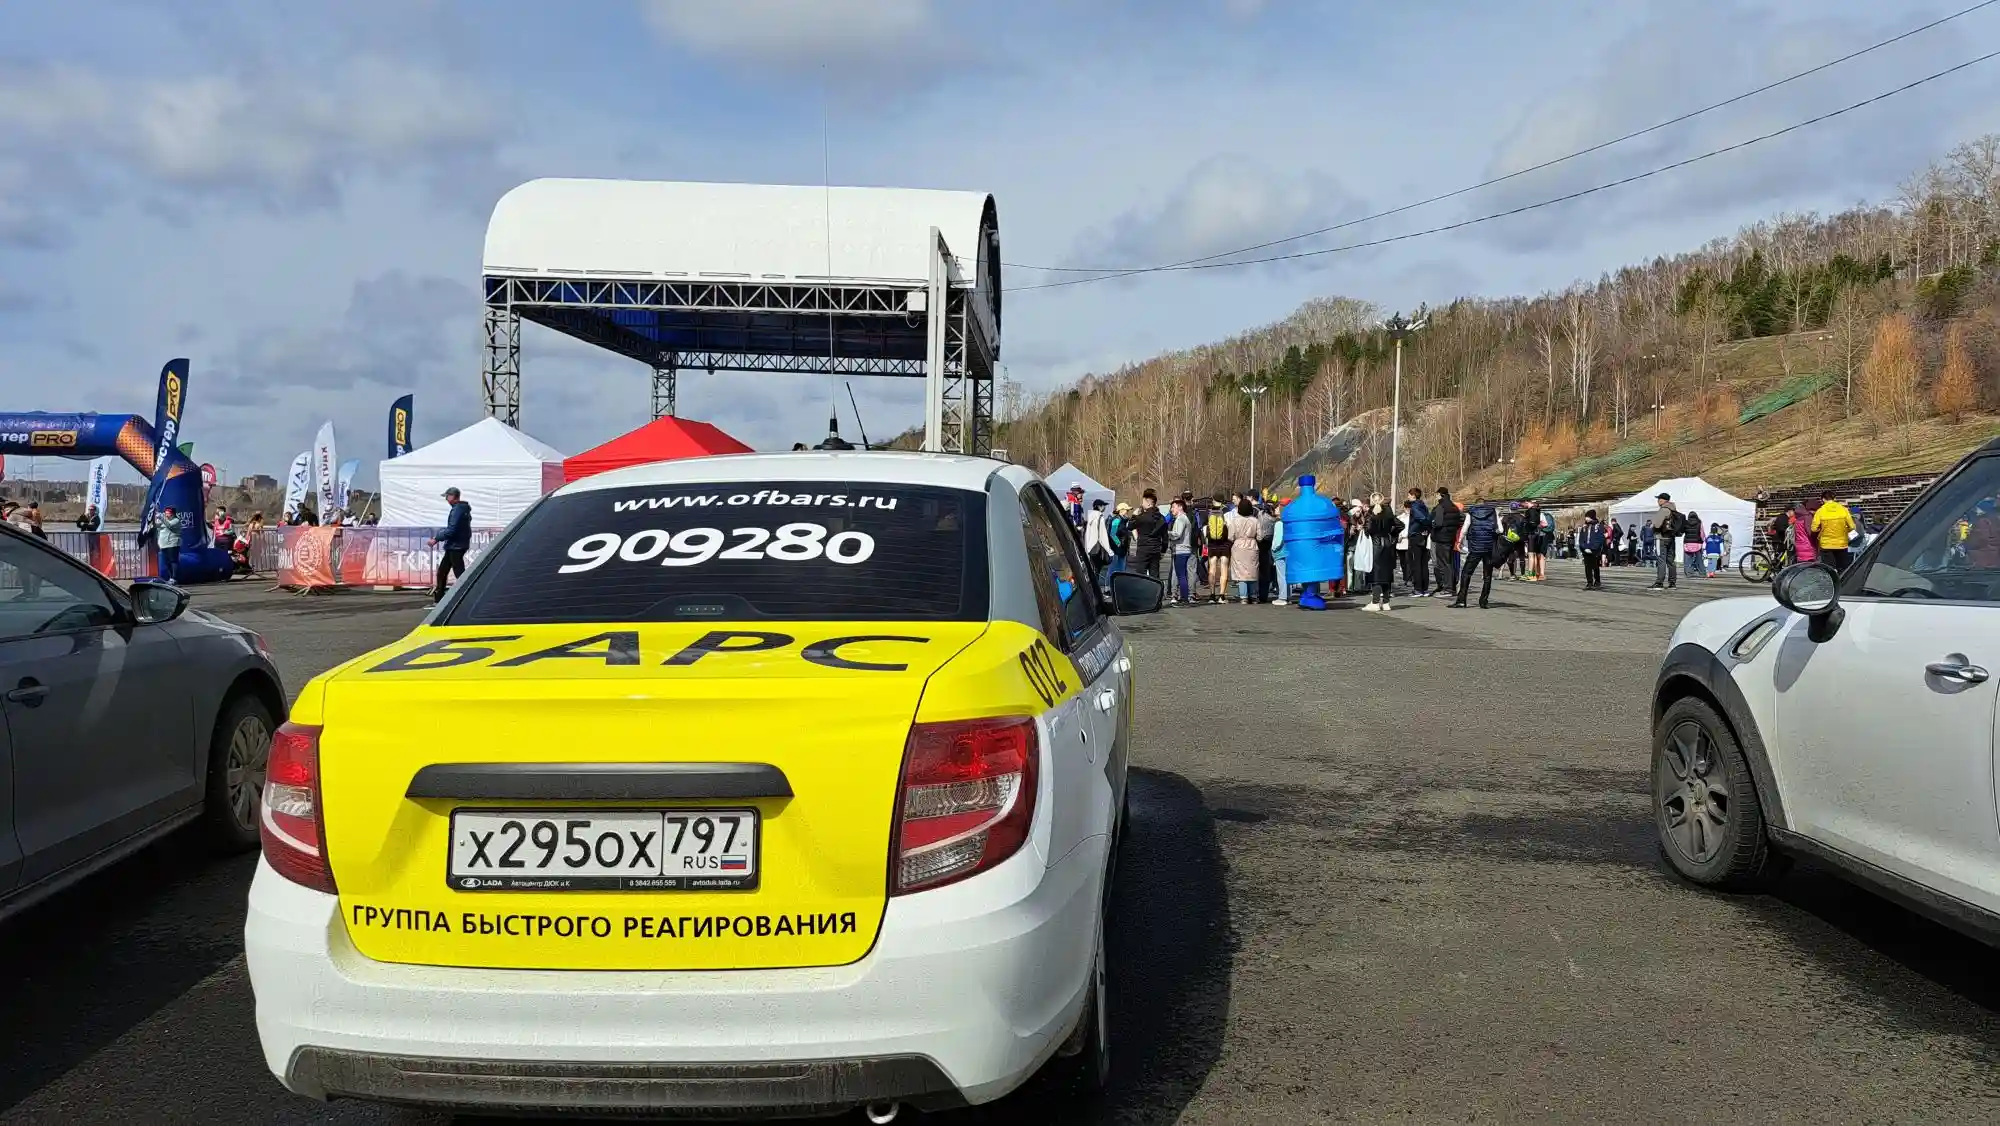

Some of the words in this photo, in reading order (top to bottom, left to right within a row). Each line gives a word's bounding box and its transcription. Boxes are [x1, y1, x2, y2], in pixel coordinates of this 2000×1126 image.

[33, 434, 73, 444] PRO
[614, 490, 897, 512] www.ofbars.ru
[558, 522, 875, 574] 909280
[363, 631, 930, 672] БАРС
[1019, 638, 1067, 708] 012
[467, 820, 656, 868] Х295ОХ
[667, 816, 741, 854] 797
[684, 856, 718, 869] RUS
[353, 905, 451, 932] ГРУППА
[462, 913, 612, 937] БЫСТРОГО
[624, 912, 856, 938] РЕАГИРОВАНИЯ
